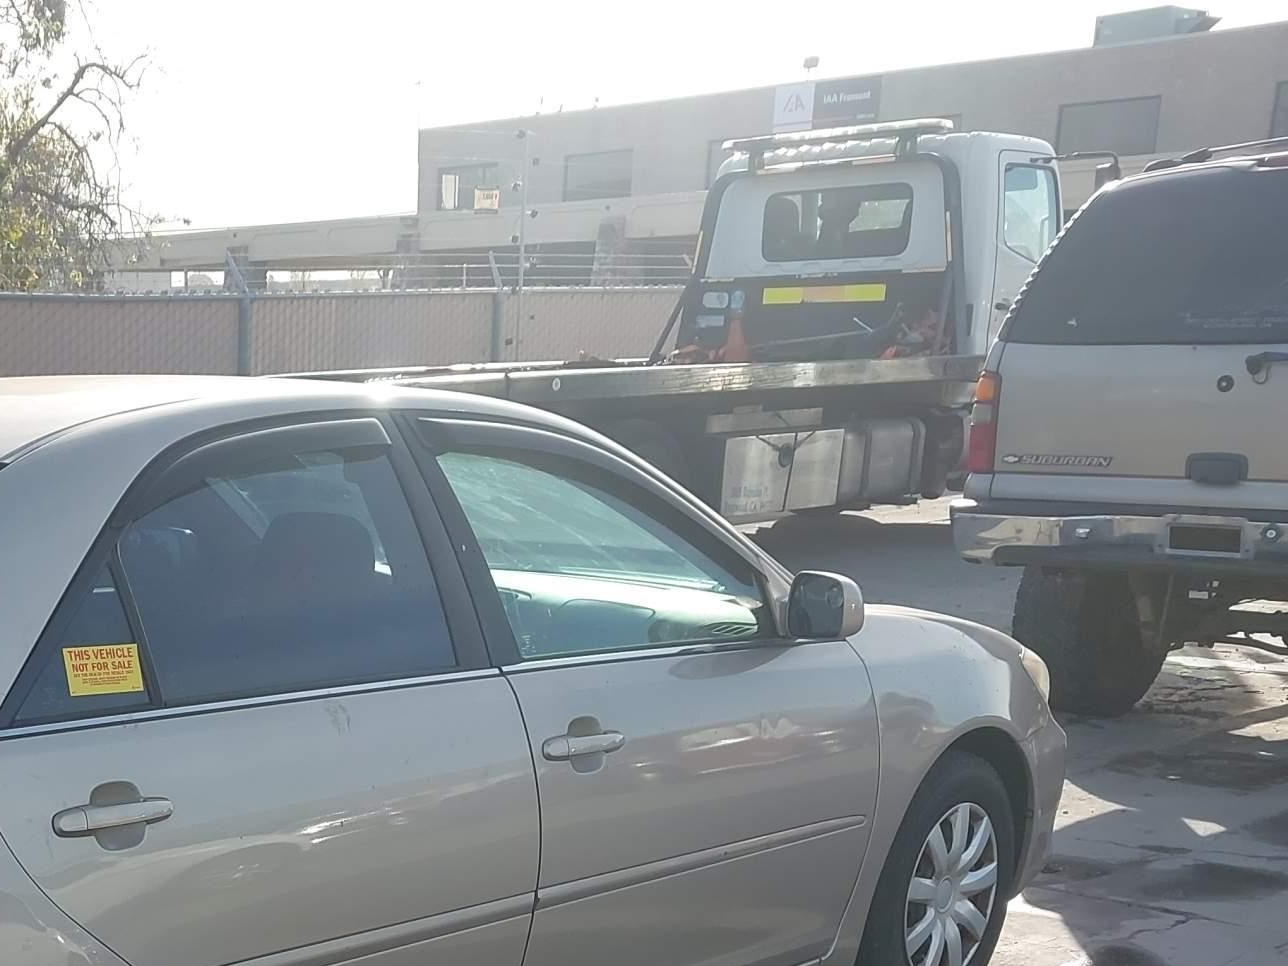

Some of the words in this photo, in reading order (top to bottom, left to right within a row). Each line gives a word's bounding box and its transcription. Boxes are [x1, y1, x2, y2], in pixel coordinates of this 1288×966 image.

[1019, 455, 1112, 468] SUBURBAN
[66, 649, 91, 661] THIS
[92, 647, 134, 660] VEHICLE
[72, 662, 89, 672] NOT
[92, 661, 110, 671] FOR
[112, 660, 134, 670] SALE
